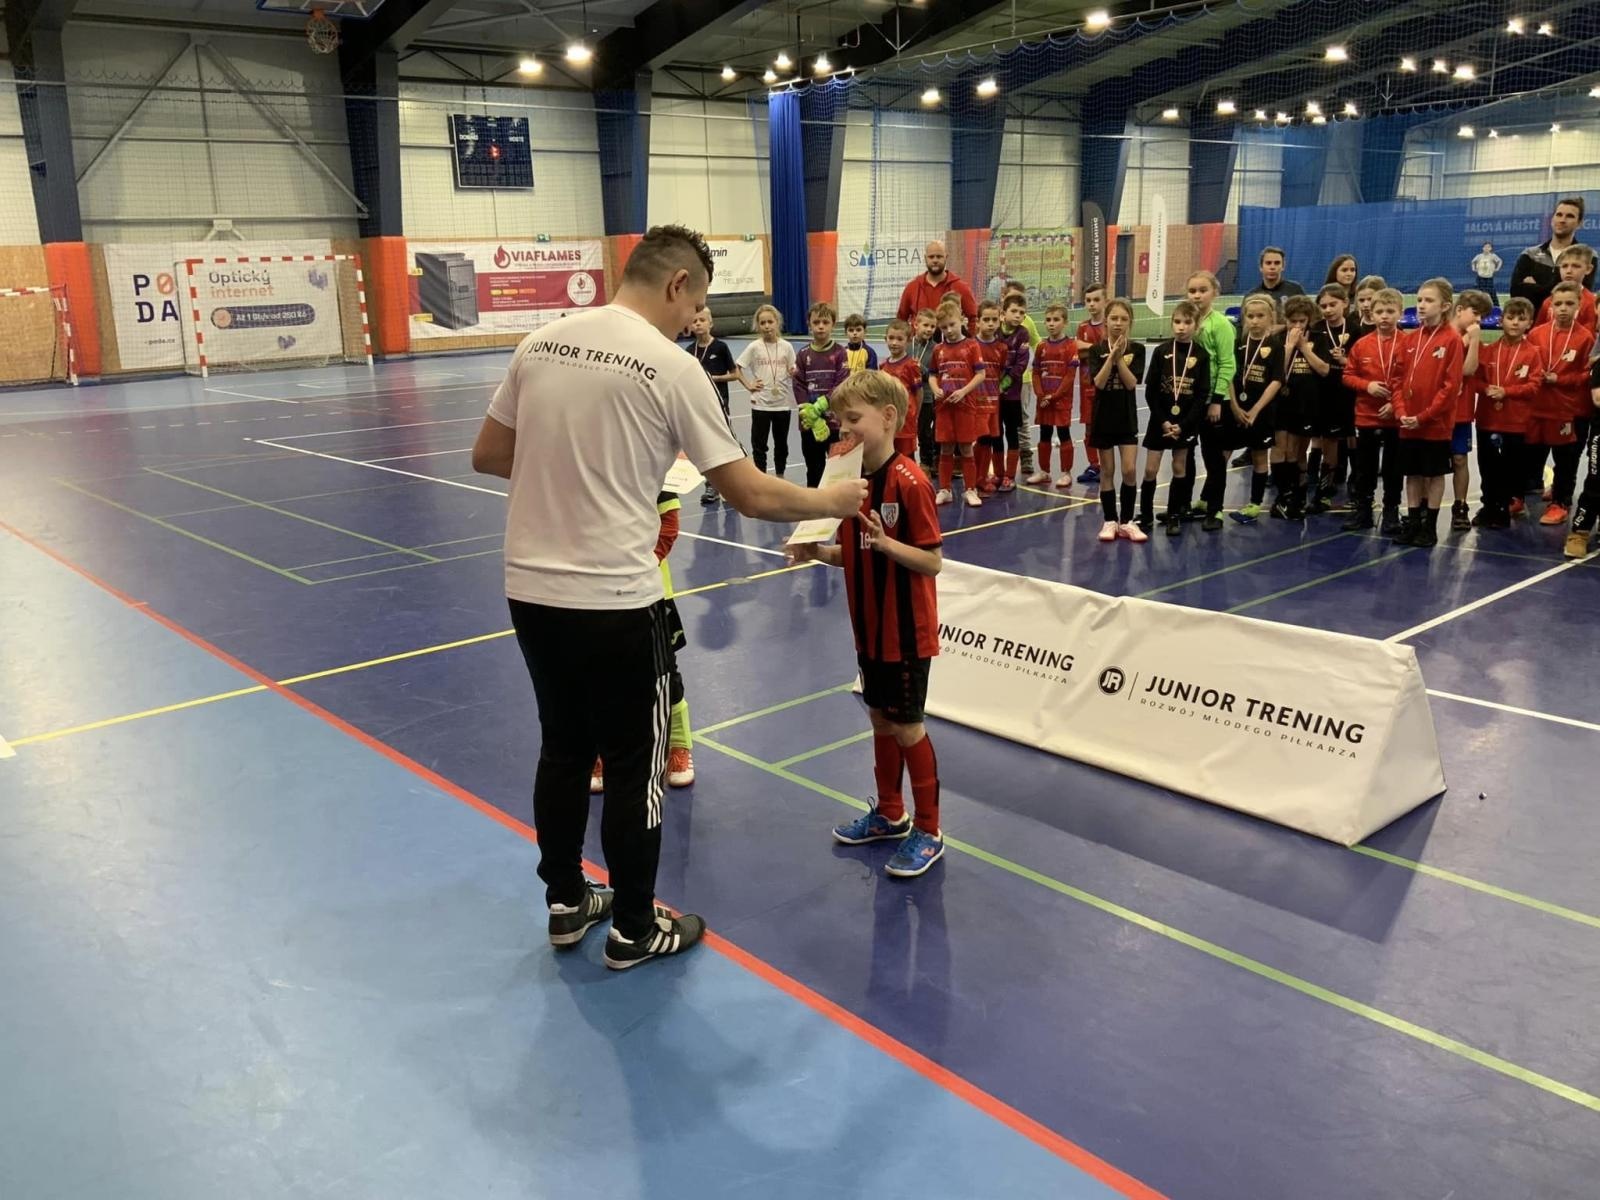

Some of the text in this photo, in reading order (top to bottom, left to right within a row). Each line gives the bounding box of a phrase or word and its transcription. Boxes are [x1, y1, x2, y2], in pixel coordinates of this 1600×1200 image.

[511, 250, 582, 261] VIAFLAMES
[709, 247, 728, 257] min
[208, 270, 271, 285] Optický
[210, 285, 275, 299] internet
[528, 341, 657, 381] JUNIOR TRENING
[937, 623, 1075, 671] NIOR TRENING
[961, 651, 1010, 669] MŁODEGO
[1145, 676, 1365, 744] JUNIOR TRENING
[1140, 698, 1358, 759] ROZWÓJ MŁODEGO PIŁKARZA
